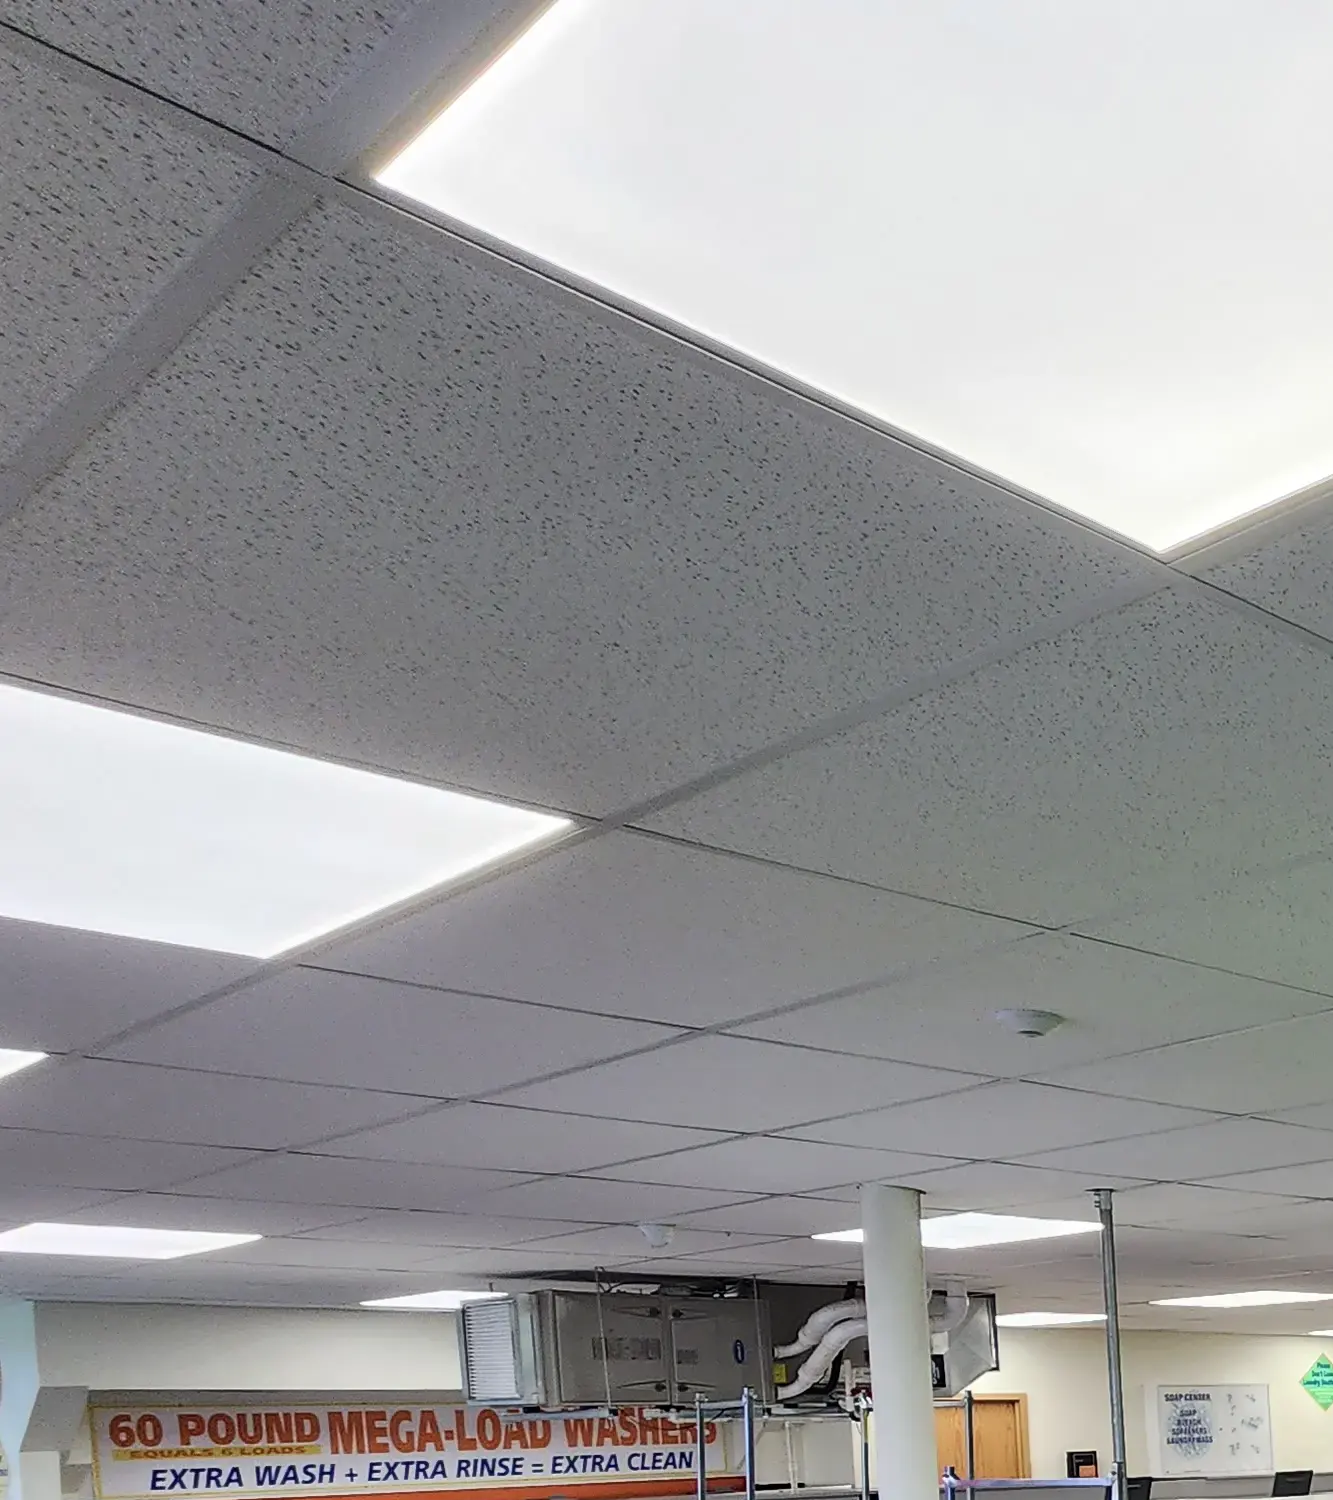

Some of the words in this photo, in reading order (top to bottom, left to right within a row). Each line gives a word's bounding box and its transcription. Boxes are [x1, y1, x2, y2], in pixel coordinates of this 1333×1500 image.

[108, 1413, 163, 1447] 60
[177, 1411, 321, 1446] POUND
[328, 1409, 551, 1455] MEGA-LOAD
[130, 1449, 214, 1459] EQUALS
[240, 1446, 307, 1456] LOADS
[150, 1466, 243, 1491] EXTRA
[255, 1463, 336, 1487] WASH
[367, 1459, 447, 1482] EXTRA
[456, 1457, 524, 1478] RINSE
[551, 1454, 619, 1475] EXTRA
[628, 1451, 694, 1471] CLEAN
